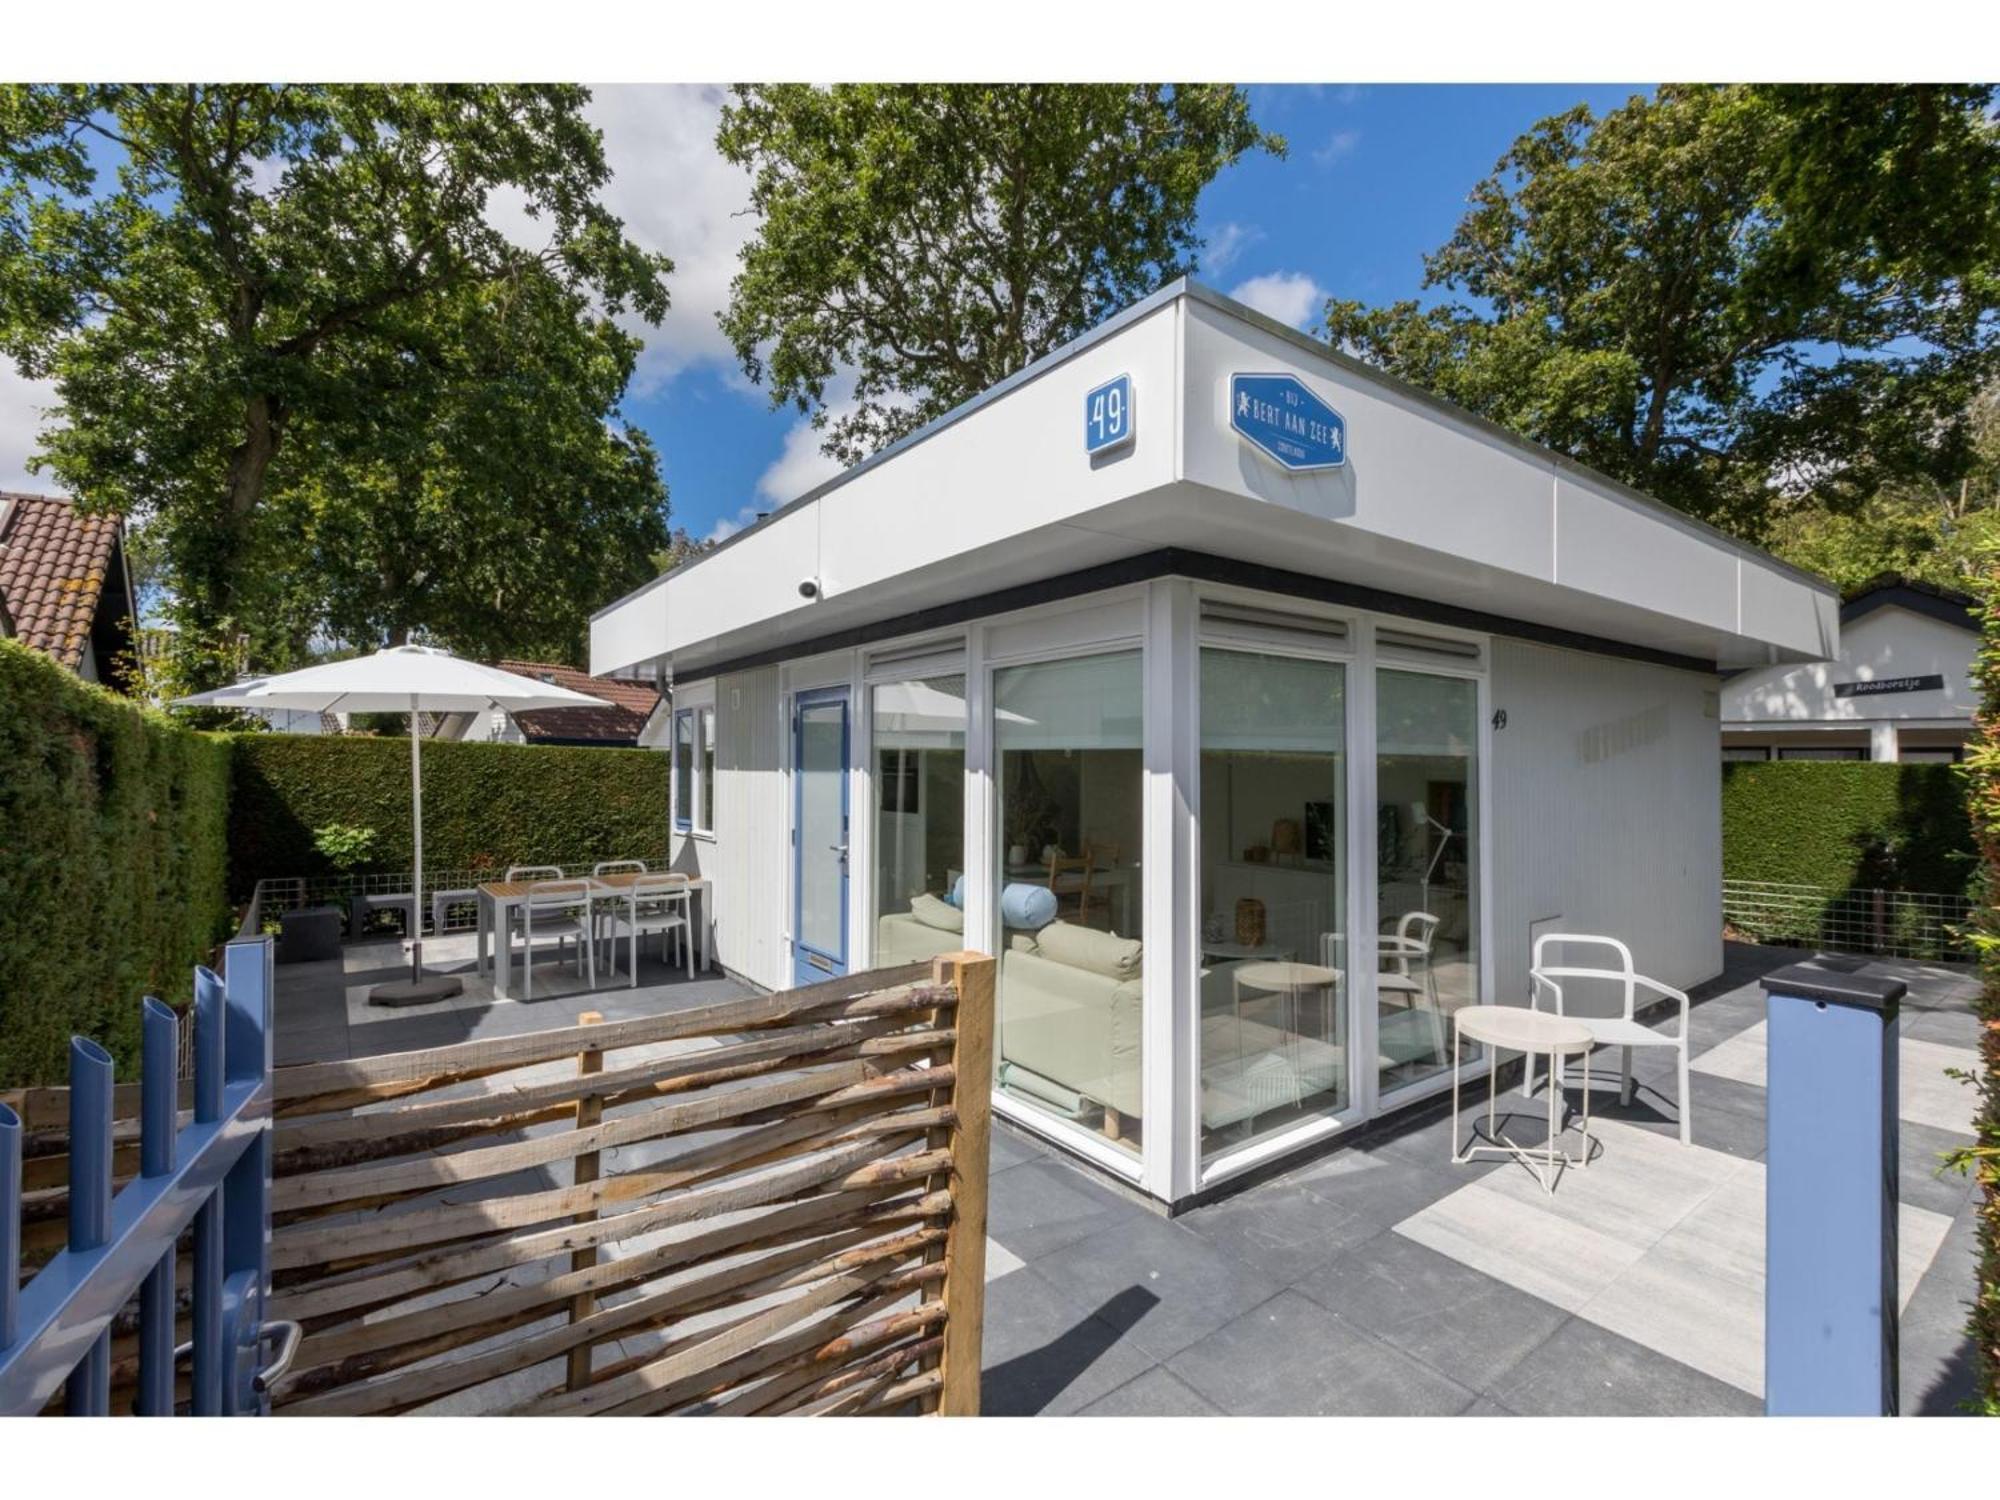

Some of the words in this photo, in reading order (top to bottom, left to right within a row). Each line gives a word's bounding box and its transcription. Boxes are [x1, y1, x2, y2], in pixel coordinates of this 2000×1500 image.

[1092, 388, 1121, 439] 49
[1253, 398, 1280, 426] BERT
[1285, 411, 1305, 436] AAN
[1310, 420, 1327, 445] ZEE
[1491, 708, 1507, 731] 49
